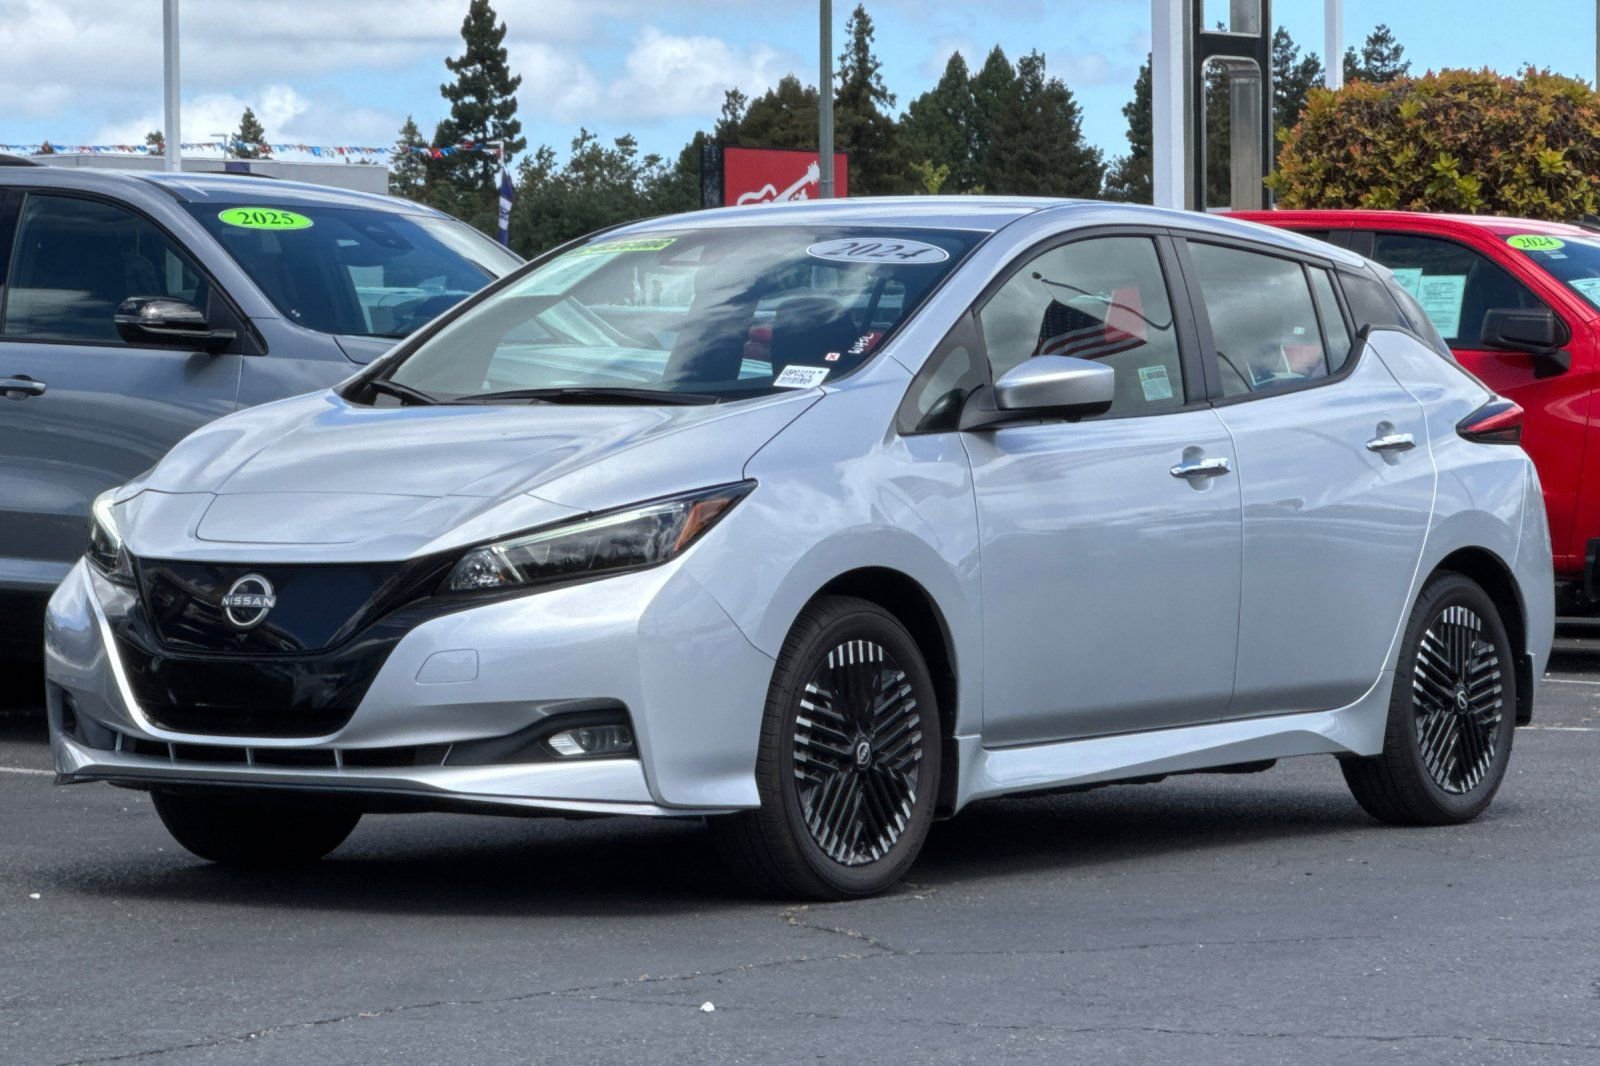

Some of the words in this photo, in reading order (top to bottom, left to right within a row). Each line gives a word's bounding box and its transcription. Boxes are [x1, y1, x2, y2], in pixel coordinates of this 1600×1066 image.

[237, 212, 294, 225] 2025
[1517, 237, 1554, 248] 2024
[823, 242, 934, 259] 2024
[222, 596, 275, 607] NISSAN
